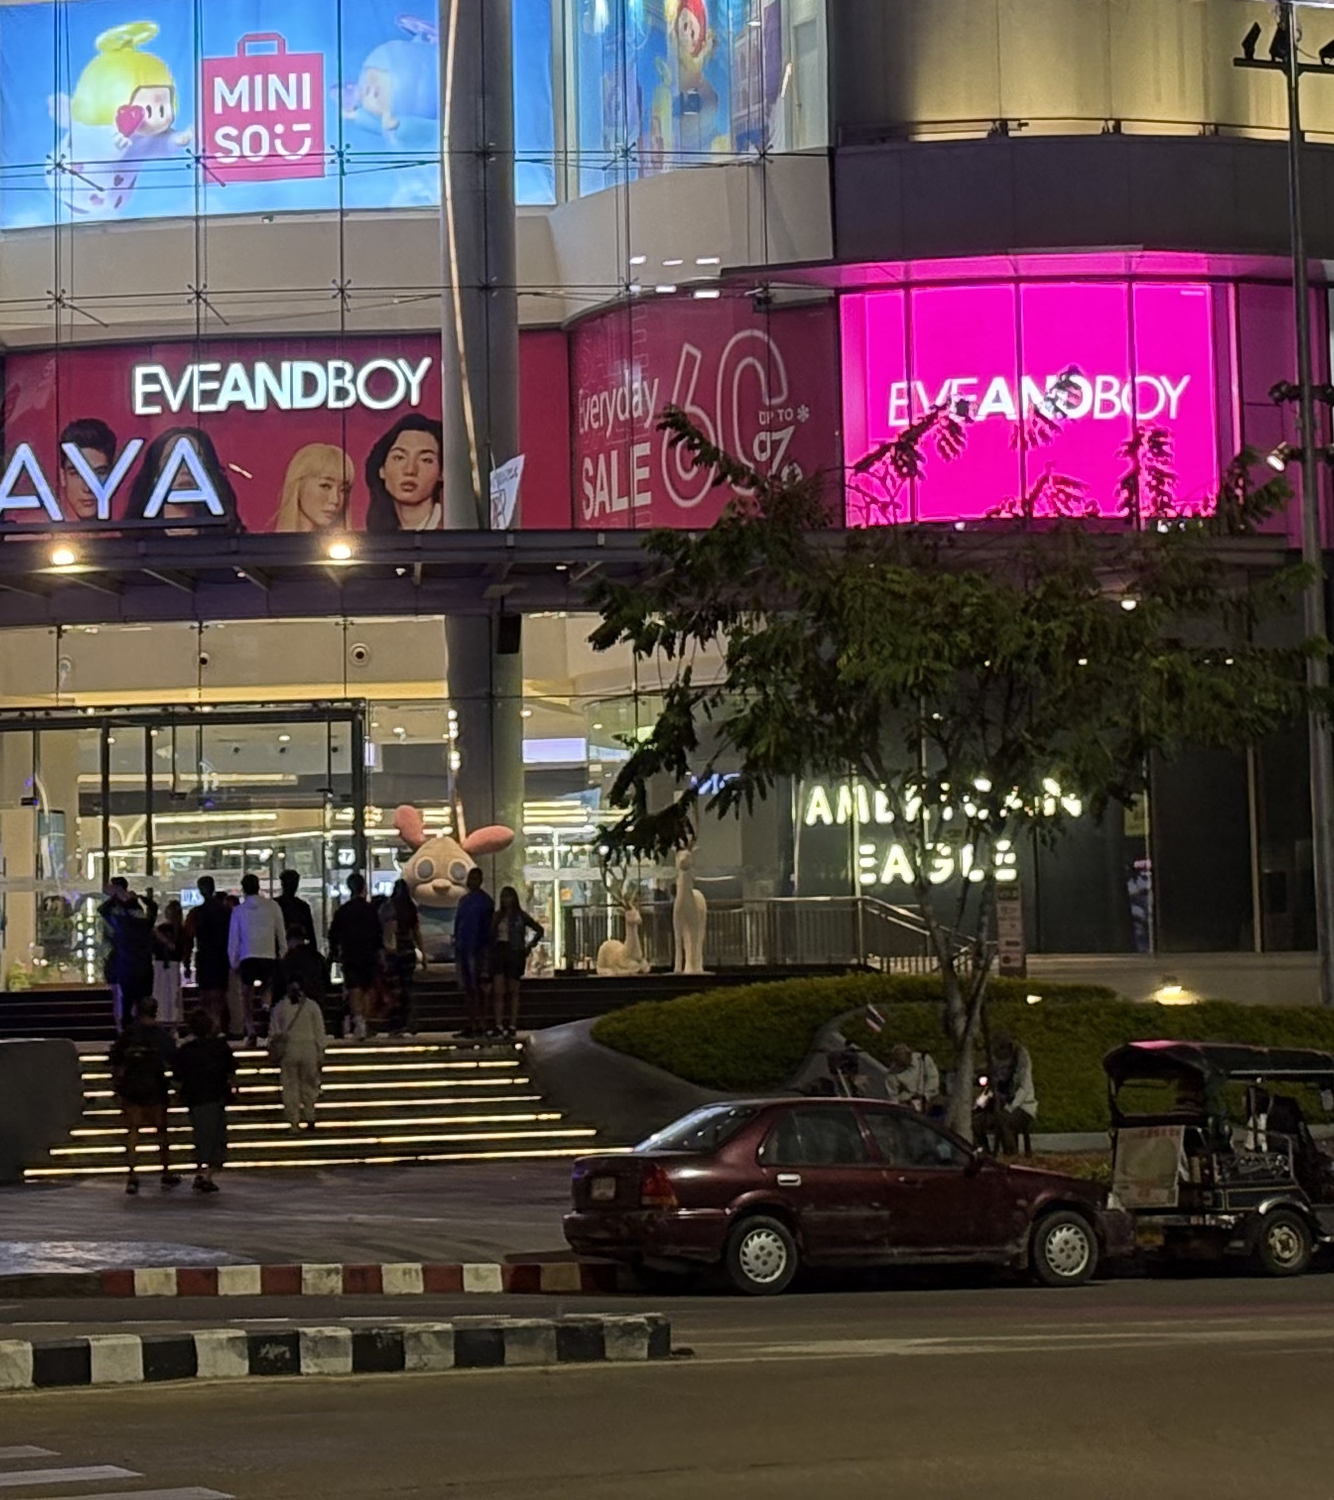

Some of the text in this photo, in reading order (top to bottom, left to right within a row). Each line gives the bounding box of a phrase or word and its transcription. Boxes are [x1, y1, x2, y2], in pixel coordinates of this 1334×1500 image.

[213, 72, 311, 114] MINI
[132, 357, 432, 415] EVEANDBOY
[578, 376, 659, 437] Everyday
[581, 442, 652, 521] SALE
